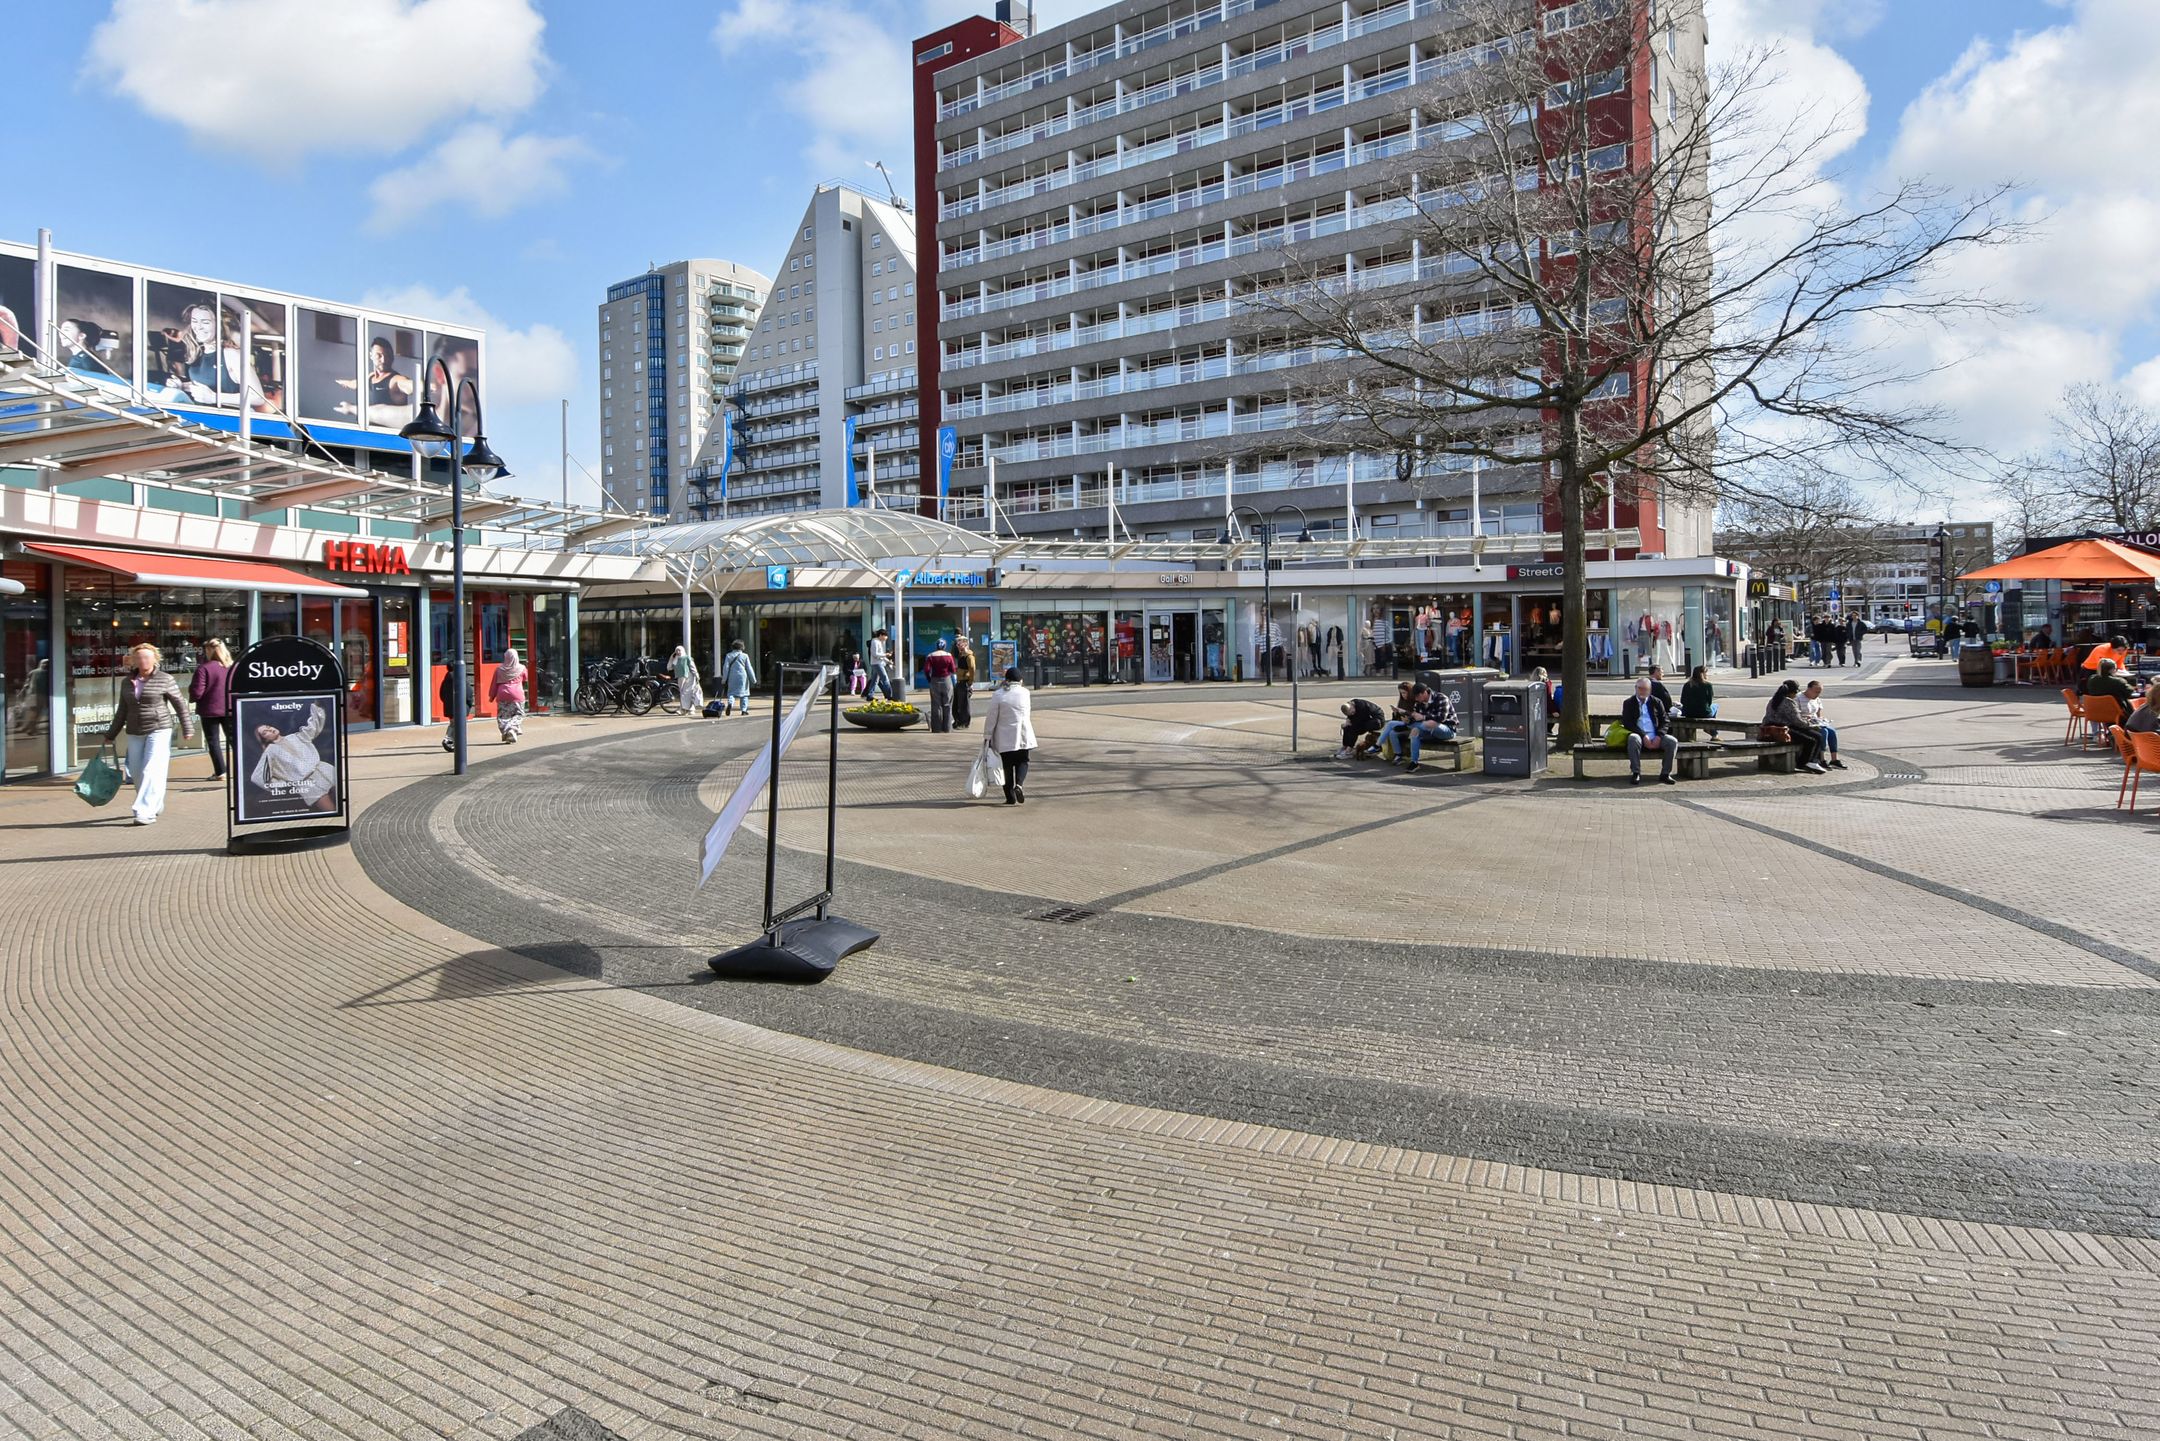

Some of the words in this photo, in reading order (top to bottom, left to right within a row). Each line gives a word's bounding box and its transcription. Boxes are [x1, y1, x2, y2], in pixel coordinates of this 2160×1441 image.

[2117, 533, 2160, 546] ALO
[325, 540, 411, 575] HEMA
[1518, 567, 1553, 577] Street
[913, 571, 953, 585] Albert
[955, 571, 985, 588] Heijn
[1160, 574, 1175, 583] Gall
[1178, 574, 1193, 583] Gall
[72, 665, 96, 676] koffie
[248, 660, 324, 681] Shoeby
[271, 702, 303, 711] shoeby
[263, 779, 316, 789] connecting
[271, 787, 287, 796] the
[289, 786, 310, 795] dots
